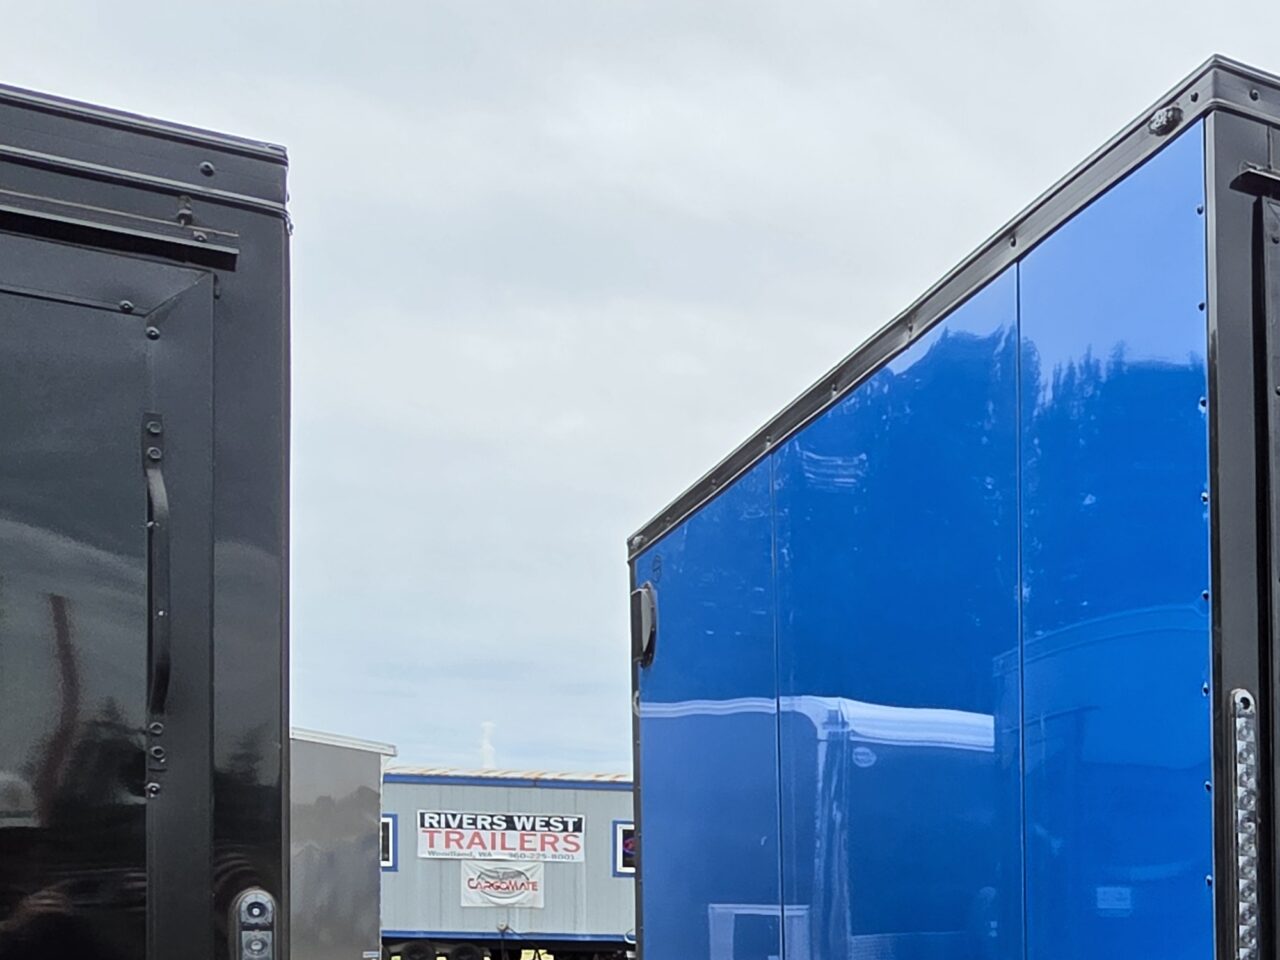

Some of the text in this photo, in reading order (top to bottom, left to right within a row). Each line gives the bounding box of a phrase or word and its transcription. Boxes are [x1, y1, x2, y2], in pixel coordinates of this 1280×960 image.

[424, 813, 579, 832] RIVERS WEST
[422, 829, 581, 853] TRAILERS
